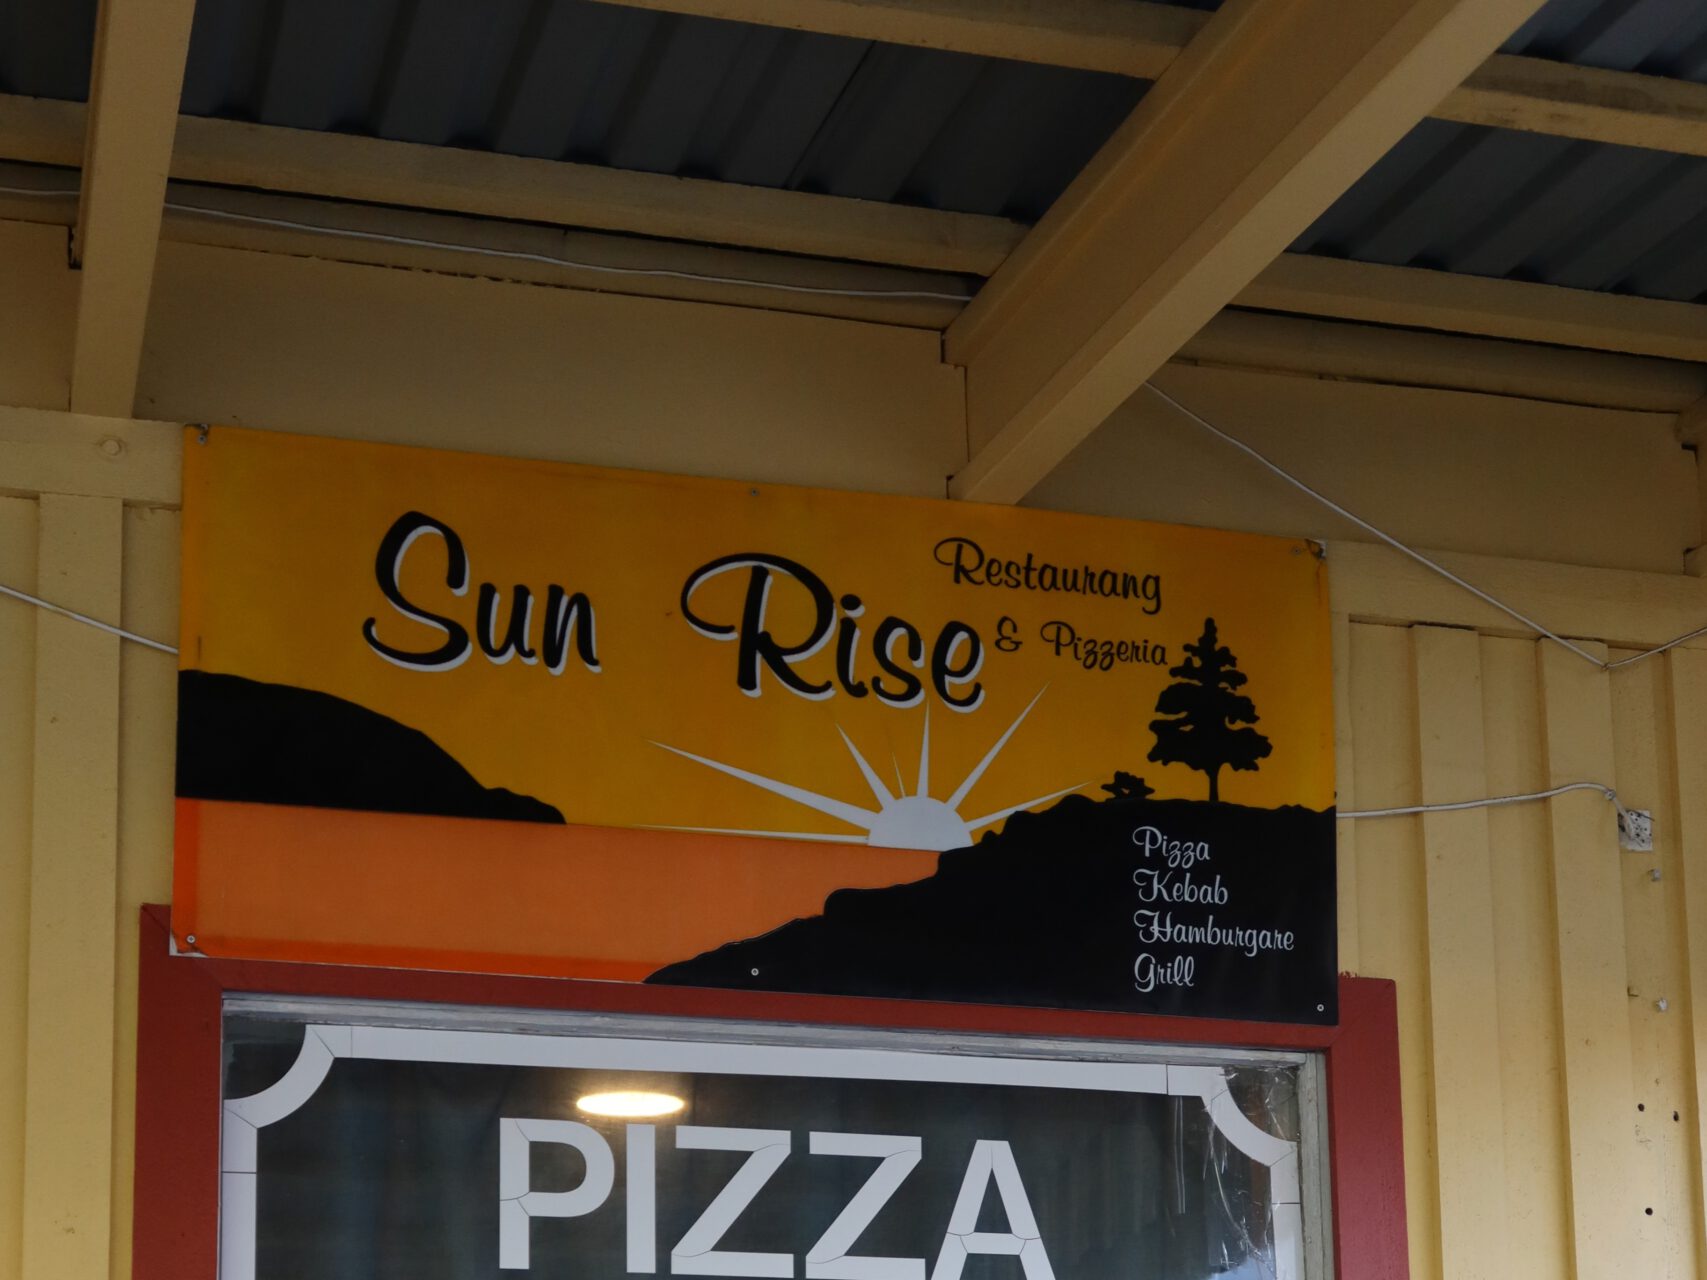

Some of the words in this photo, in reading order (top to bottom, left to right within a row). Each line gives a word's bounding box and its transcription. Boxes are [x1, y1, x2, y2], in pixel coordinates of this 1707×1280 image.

[934, 537, 1162, 615] Restaurang
[362, 511, 600, 674] Sun
[681, 552, 985, 713] Rise
[995, 616, 1023, 652] &
[1040, 621, 1169, 671] Pizzeria
[1132, 825, 1211, 869] Pizza
[1133, 869, 1229, 905] Kebab
[1133, 909, 1295, 957] Hamburgare
[1134, 953, 1195, 993] Grill
